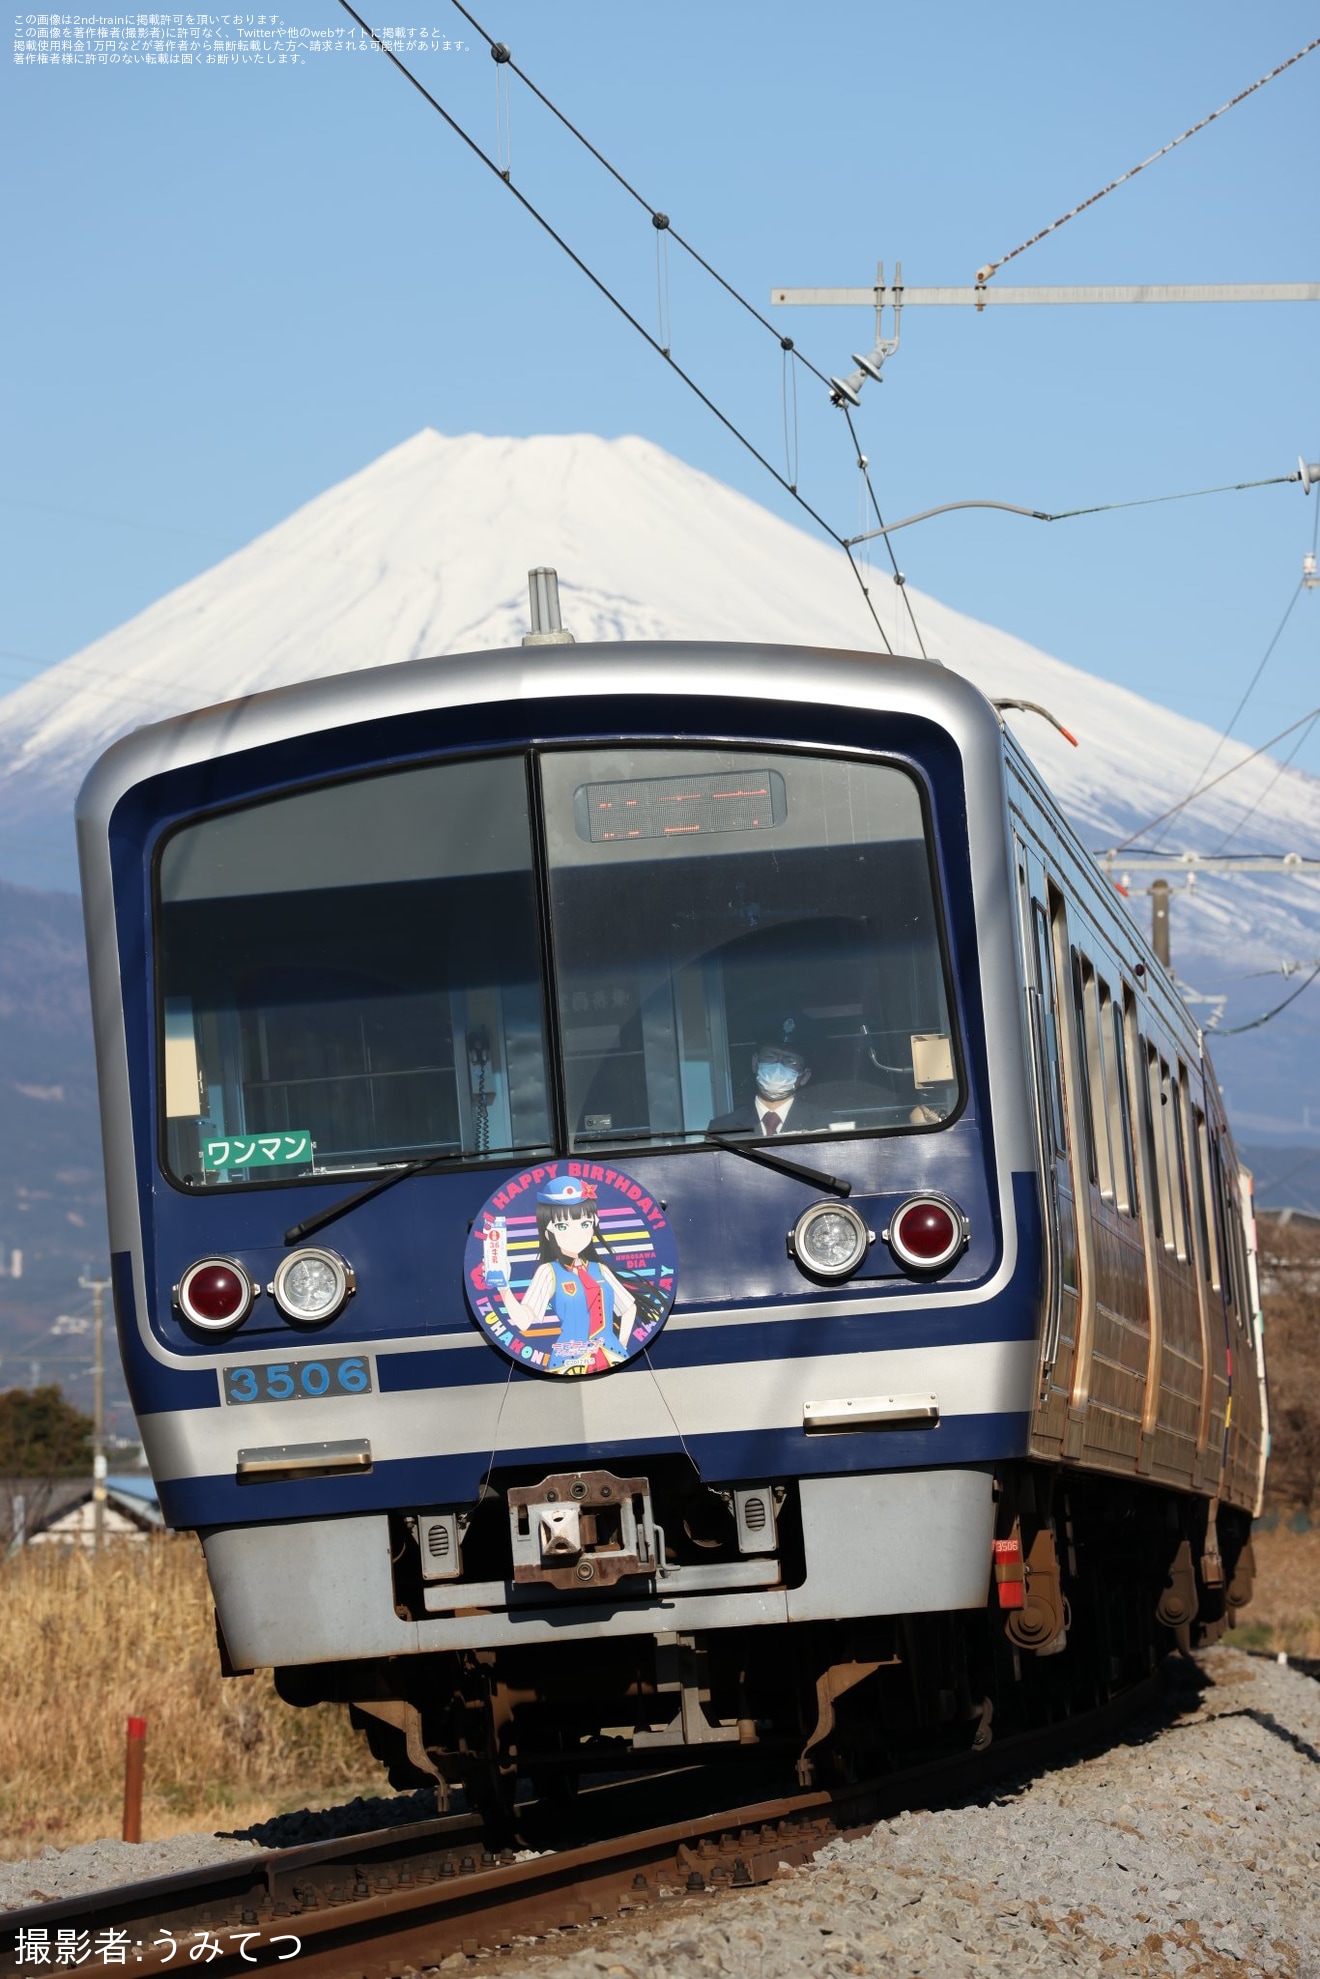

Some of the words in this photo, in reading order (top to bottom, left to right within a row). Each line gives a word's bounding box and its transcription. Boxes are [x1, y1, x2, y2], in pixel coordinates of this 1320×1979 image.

[208, 1136, 308, 1166] ワンマン
[492, 1163, 559, 1209] HAPPY
[568, 1162, 666, 1230] BIRTHDAY!
[626, 1259, 647, 1269] DIA
[230, 1358, 369, 1403] 3506
[996, 1540, 1018, 1552] 3506
